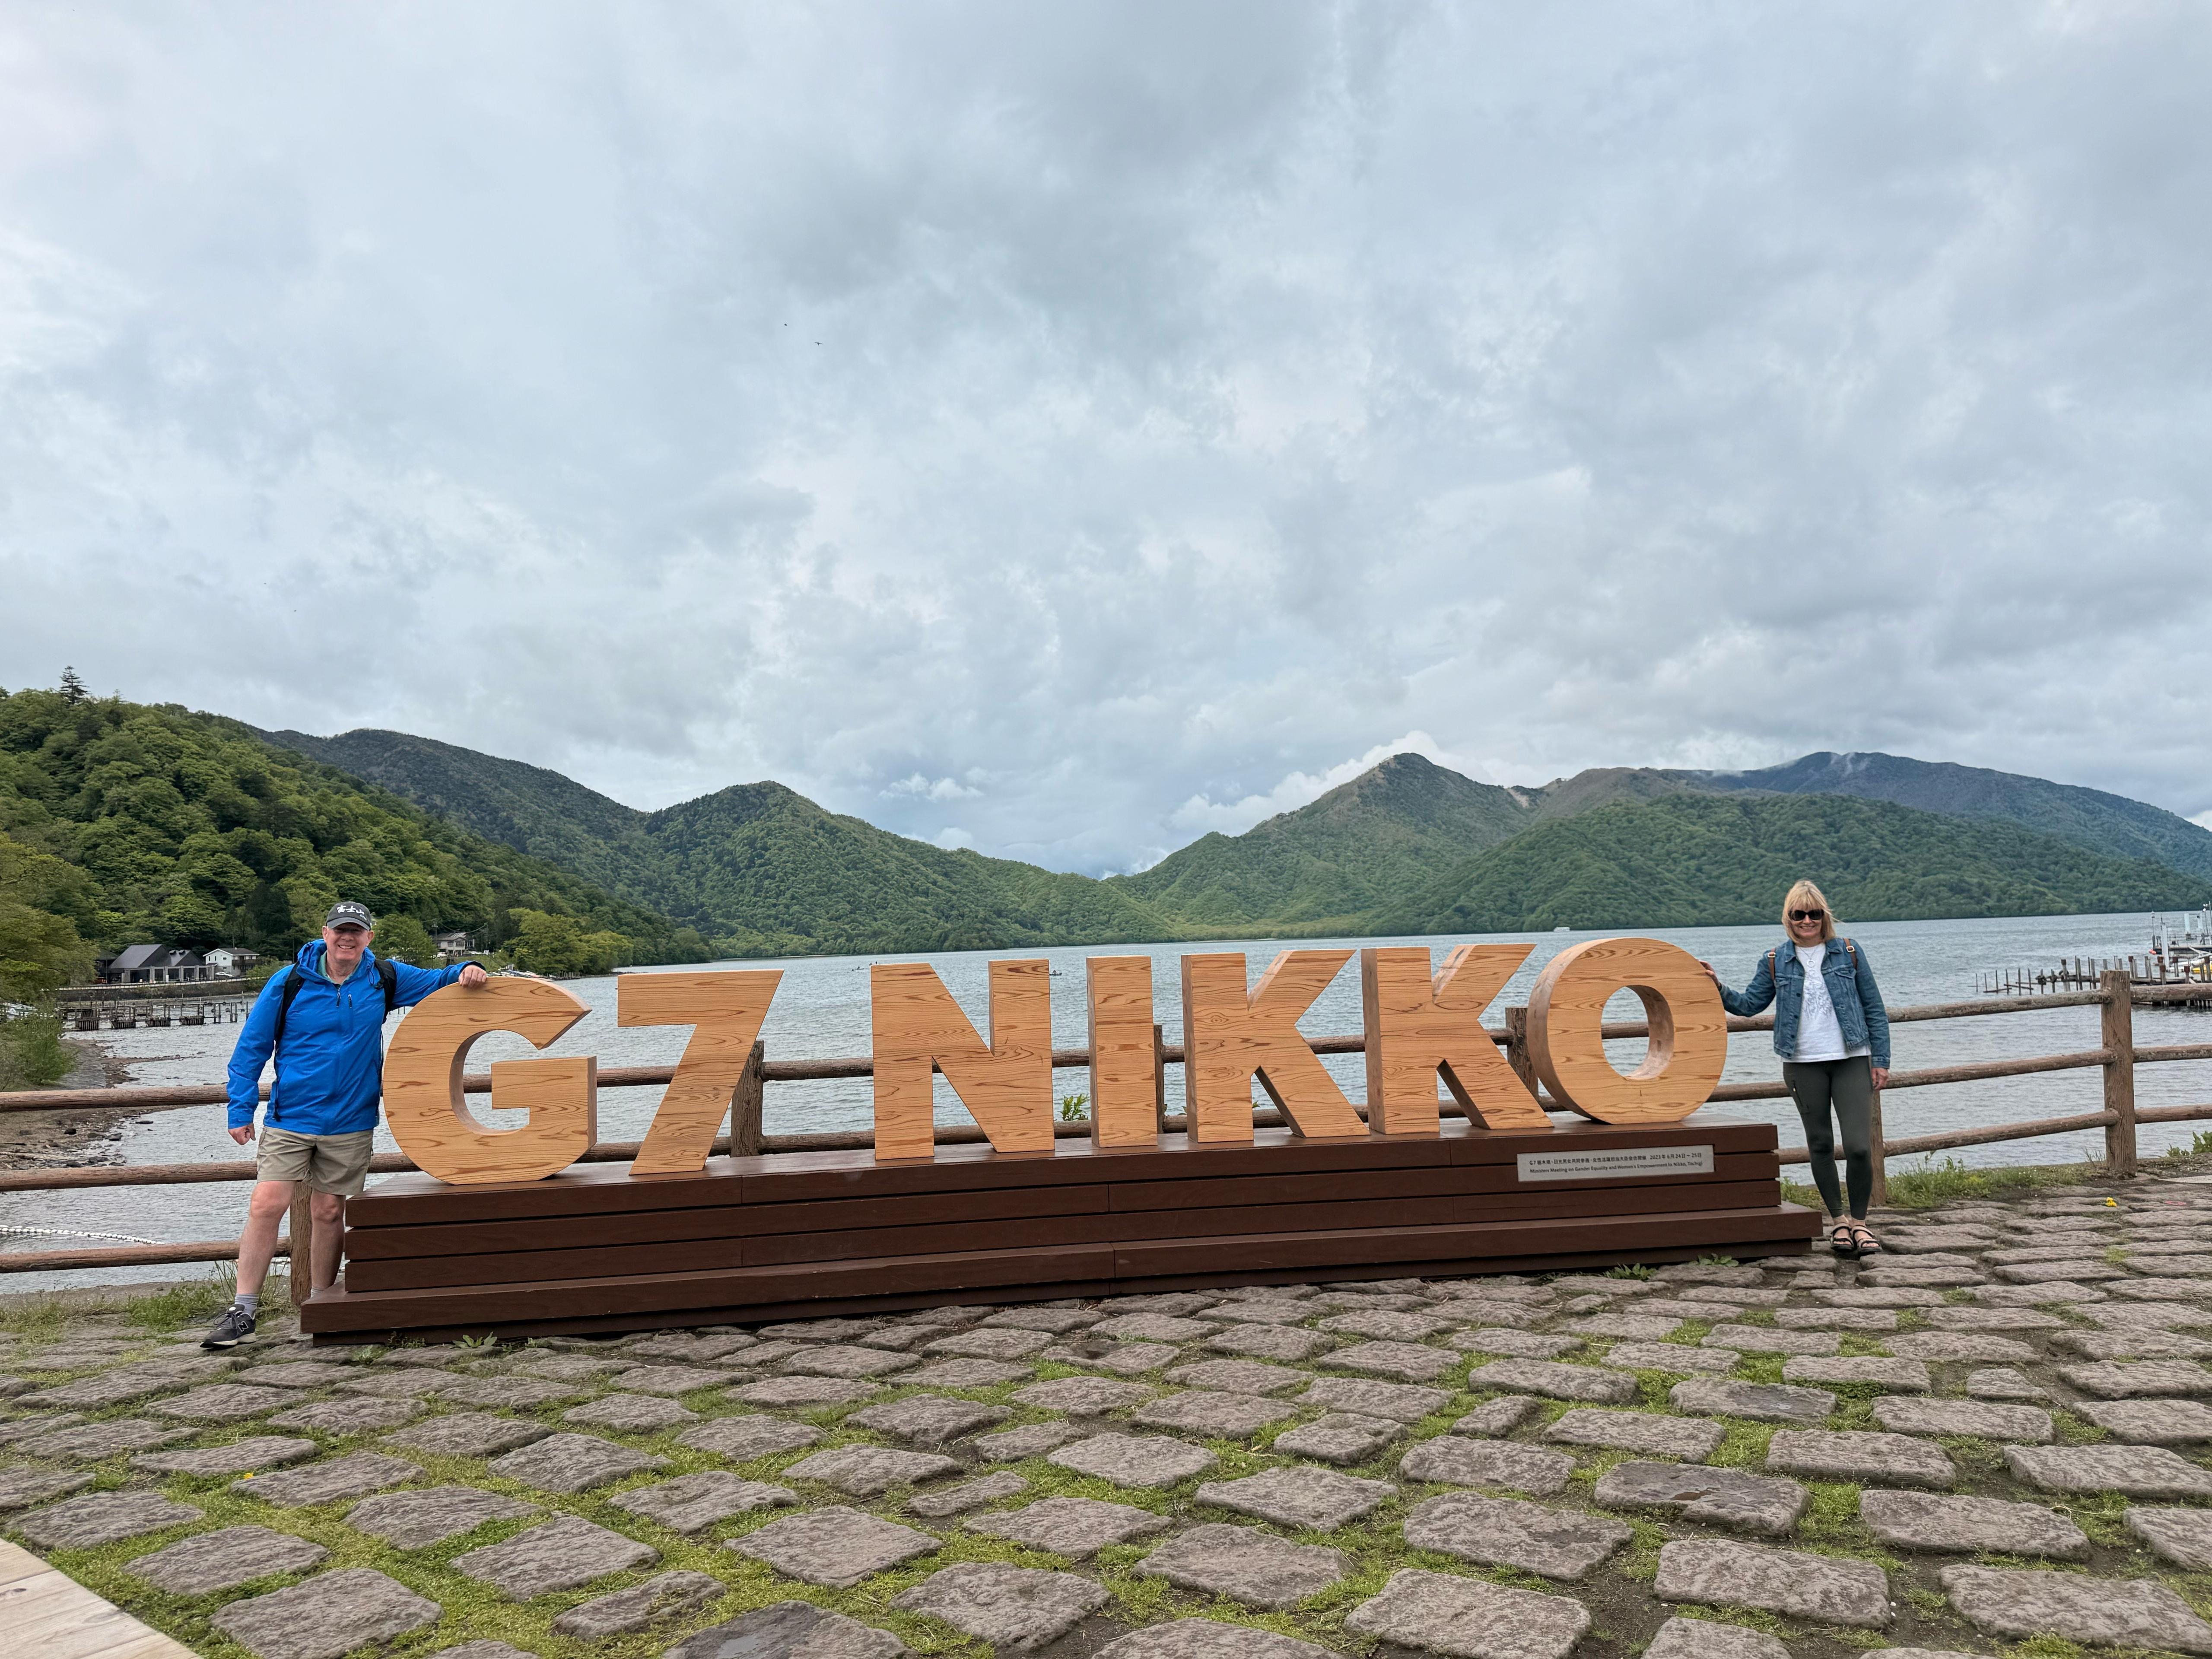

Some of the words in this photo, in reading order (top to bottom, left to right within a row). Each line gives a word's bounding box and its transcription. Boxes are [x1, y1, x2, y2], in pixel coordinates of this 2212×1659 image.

[337, 905, 365, 915] 富士山
[383, 968, 784, 1185] G7
[871, 937, 1727, 1160] NIKKO
[238, 1321, 249, 1332] N
